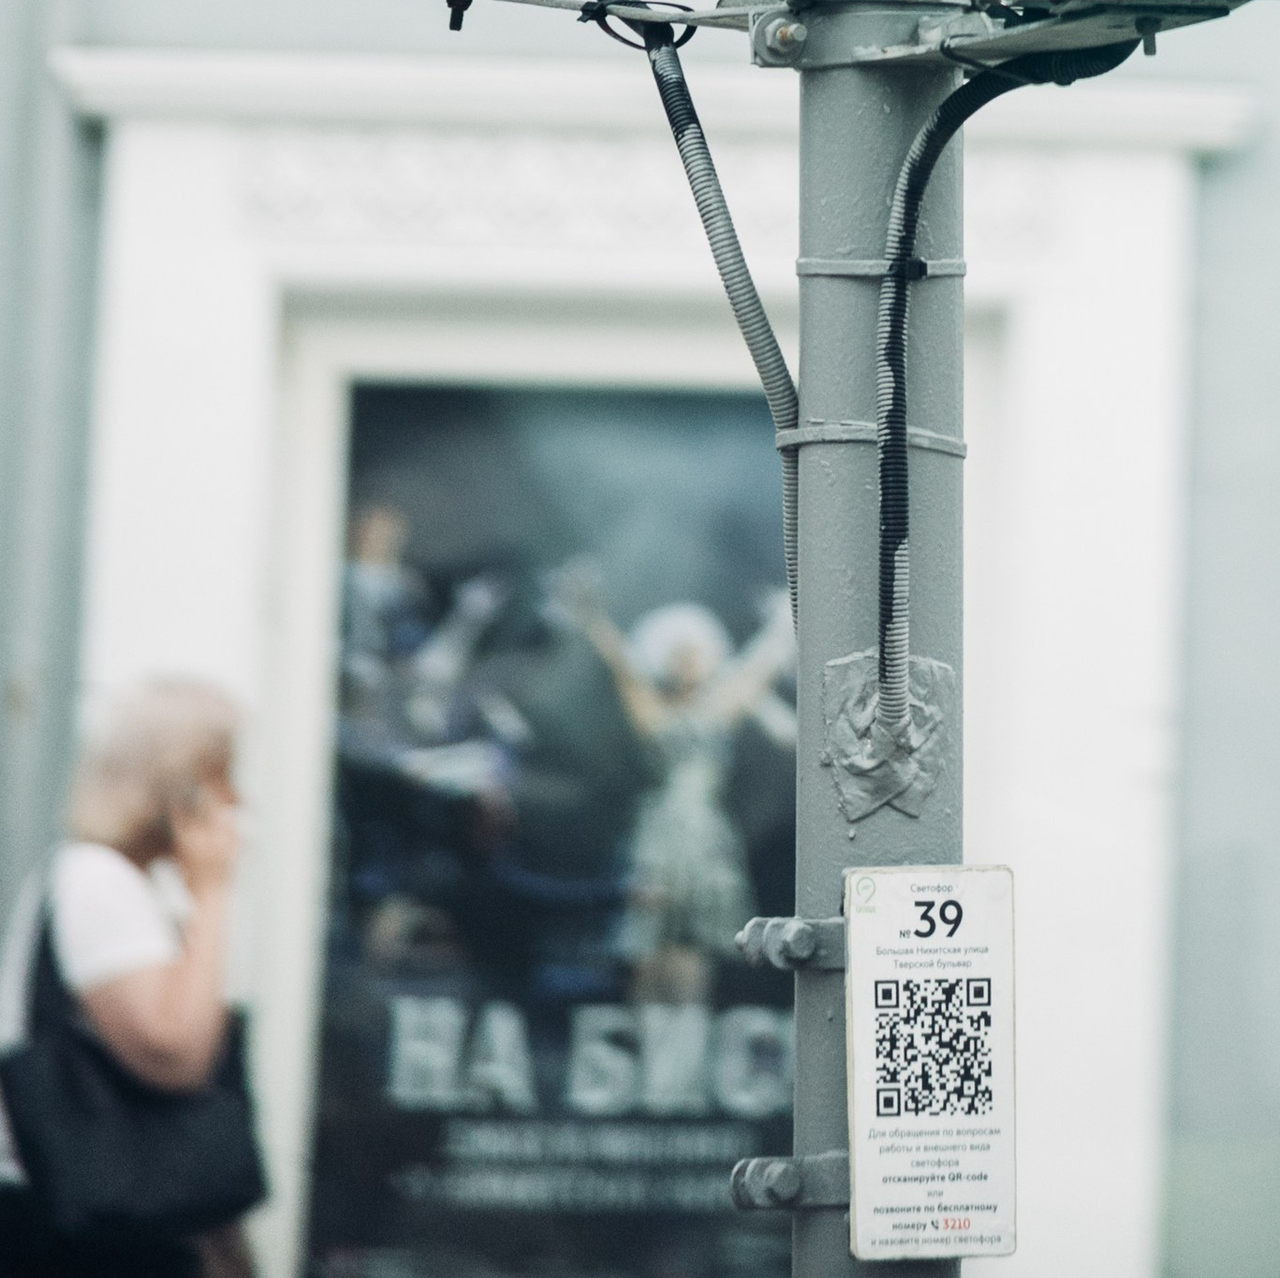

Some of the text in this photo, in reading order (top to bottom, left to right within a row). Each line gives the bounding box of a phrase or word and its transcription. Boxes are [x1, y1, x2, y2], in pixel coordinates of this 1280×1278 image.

[910, 883, 953, 894] Светофор
[913, 899, 964, 938] 39
[876, 946, 989, 956] Большая Никитская улица
[893, 959, 972, 970] Тверской бульвар
[868, 1128, 1001, 1140] Для обращения по вопросам
[879, 1144, 913, 1155] работы
[923, 1143, 967, 1152] внешнего
[969, 1143, 991, 1153] вида
[910, 1157, 959, 1169] светофора
[882, 1171, 988, 1185] отсканируйте QR-code
[927, 1190, 944, 1198] или
[873, 1206, 922, 1215] позвоните
[937, 1202, 998, 1213] бесплатному
[892, 1218, 971, 1232] номеру 3210
[878, 1238, 920, 1246] назовите
[921, 1237, 950, 1246] номер
[953, 1235, 1001, 1245] светофора
